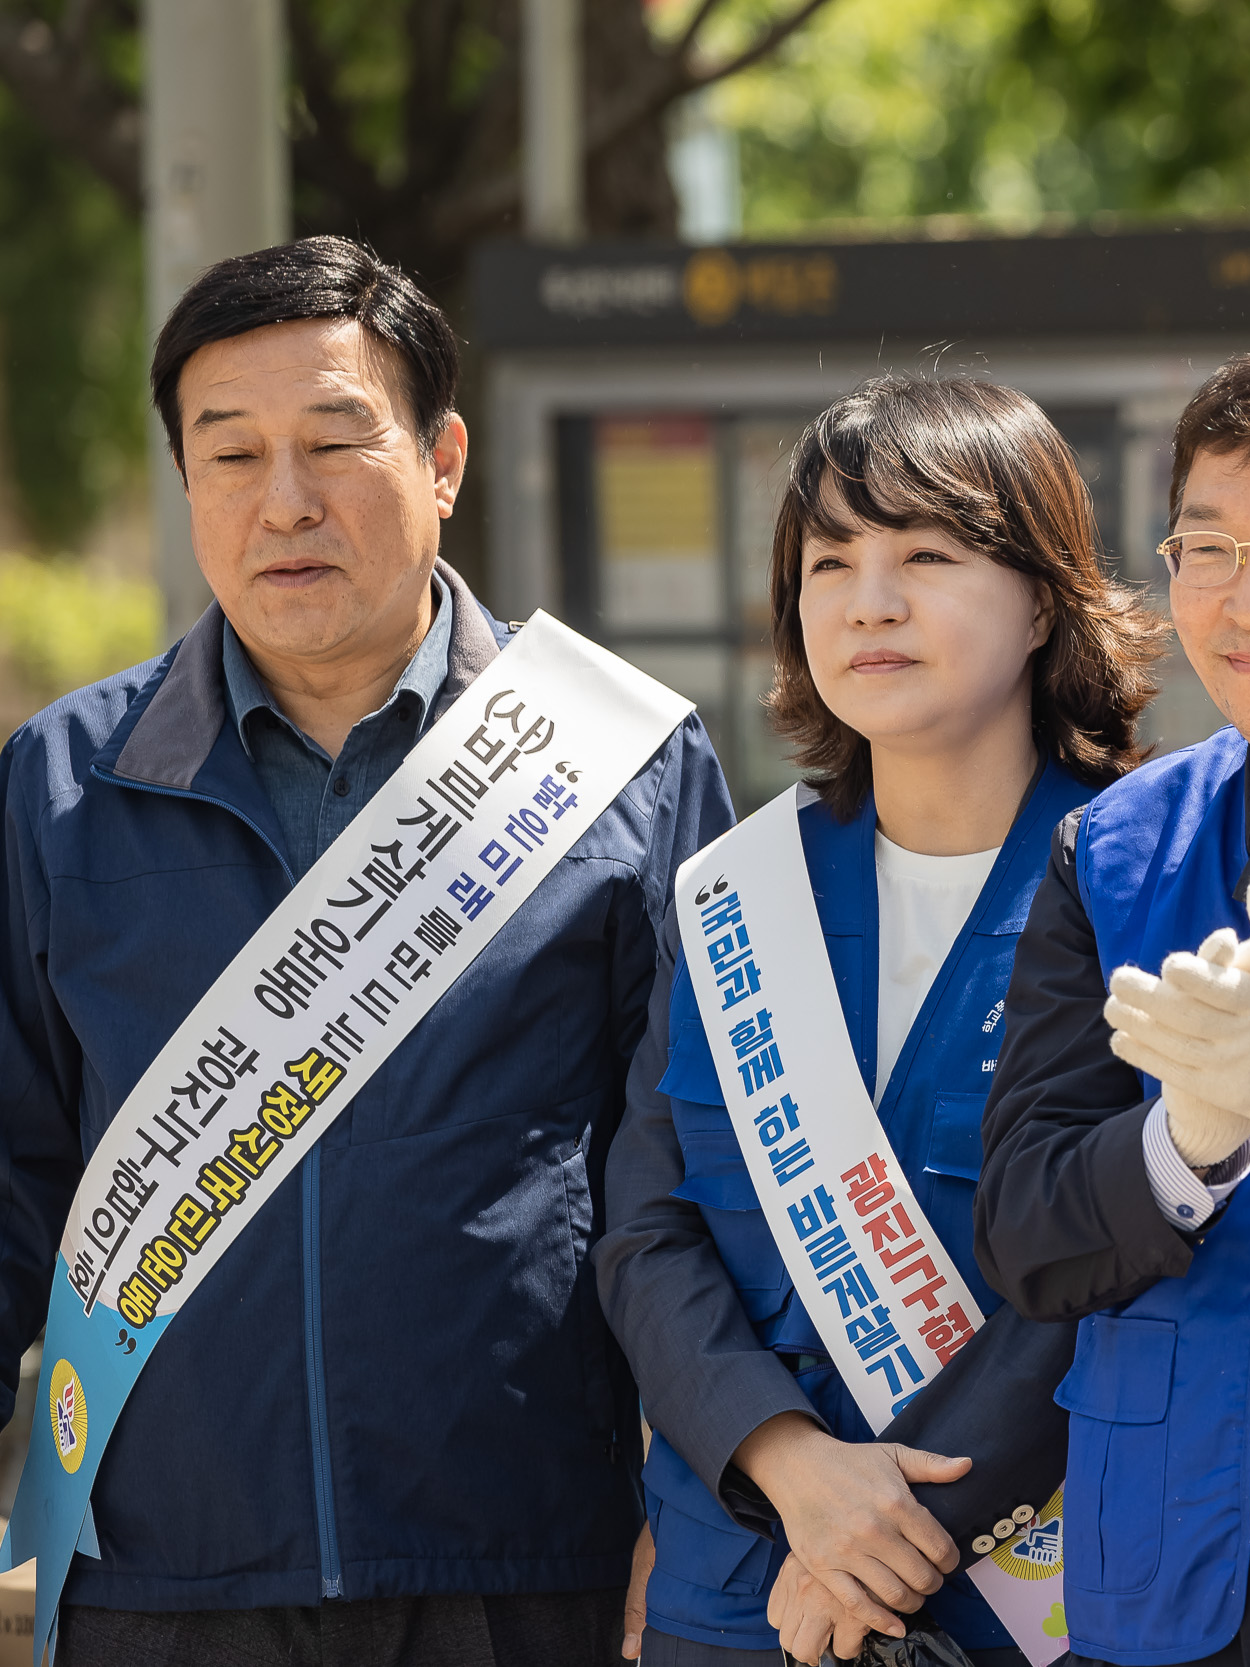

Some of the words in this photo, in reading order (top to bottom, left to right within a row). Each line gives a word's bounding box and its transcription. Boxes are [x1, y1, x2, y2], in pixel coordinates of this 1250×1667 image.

[254, 688, 555, 1021] (사)바르게살기운동
[728, 1003, 786, 1098] 함께
[754, 1093, 817, 1188] 하는
[66, 1025, 261, 1318] 광진구협의회
